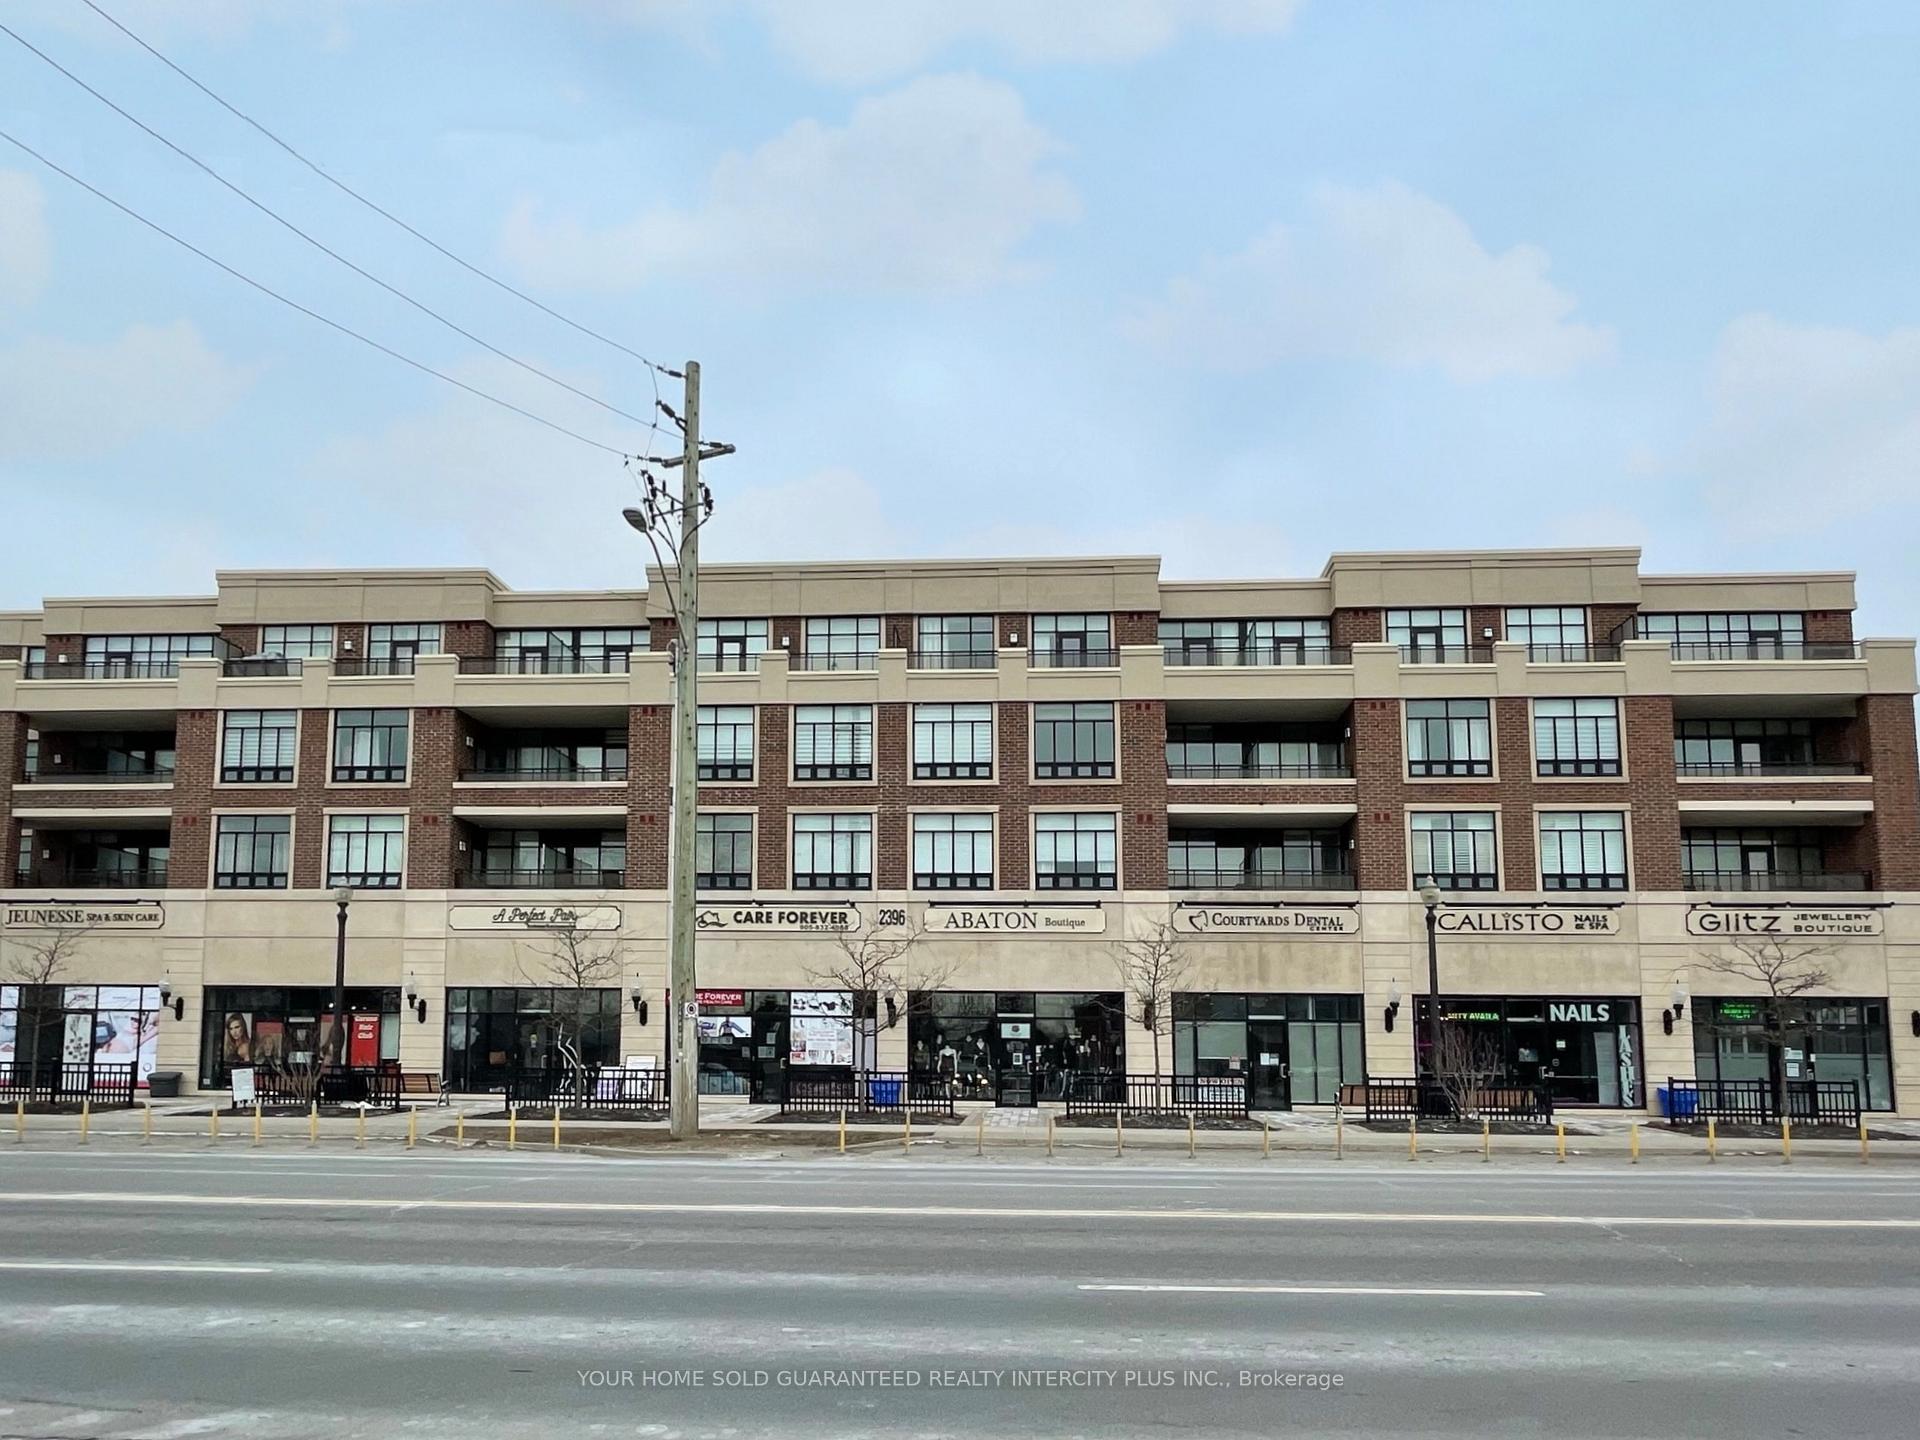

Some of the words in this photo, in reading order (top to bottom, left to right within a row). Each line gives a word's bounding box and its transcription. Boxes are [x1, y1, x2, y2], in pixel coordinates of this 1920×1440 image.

[5, 910, 85, 925] JEUNESSE
[86, 913, 102, 922] SPA
[104, 914, 111, 922] &
[113, 913, 134, 922] SKIN
[135, 913, 160, 922] CARE
[492, 908, 506, 922] A
[508, 907, 546, 922] Perfect
[733, 911, 773, 924] CARE
[778, 911, 849, 924] FOREVER
[879, 909, 906, 926] 2396
[944, 912, 1038, 929] ABATON
[1045, 917, 1086, 929] Boutique
[1212, 913, 1290, 926] COURTYARDS
[1294, 913, 1344, 926] DENTAL
[1574, 914, 1608, 922] NAILS
[1550, 1003, 1610, 1022] NAILS
